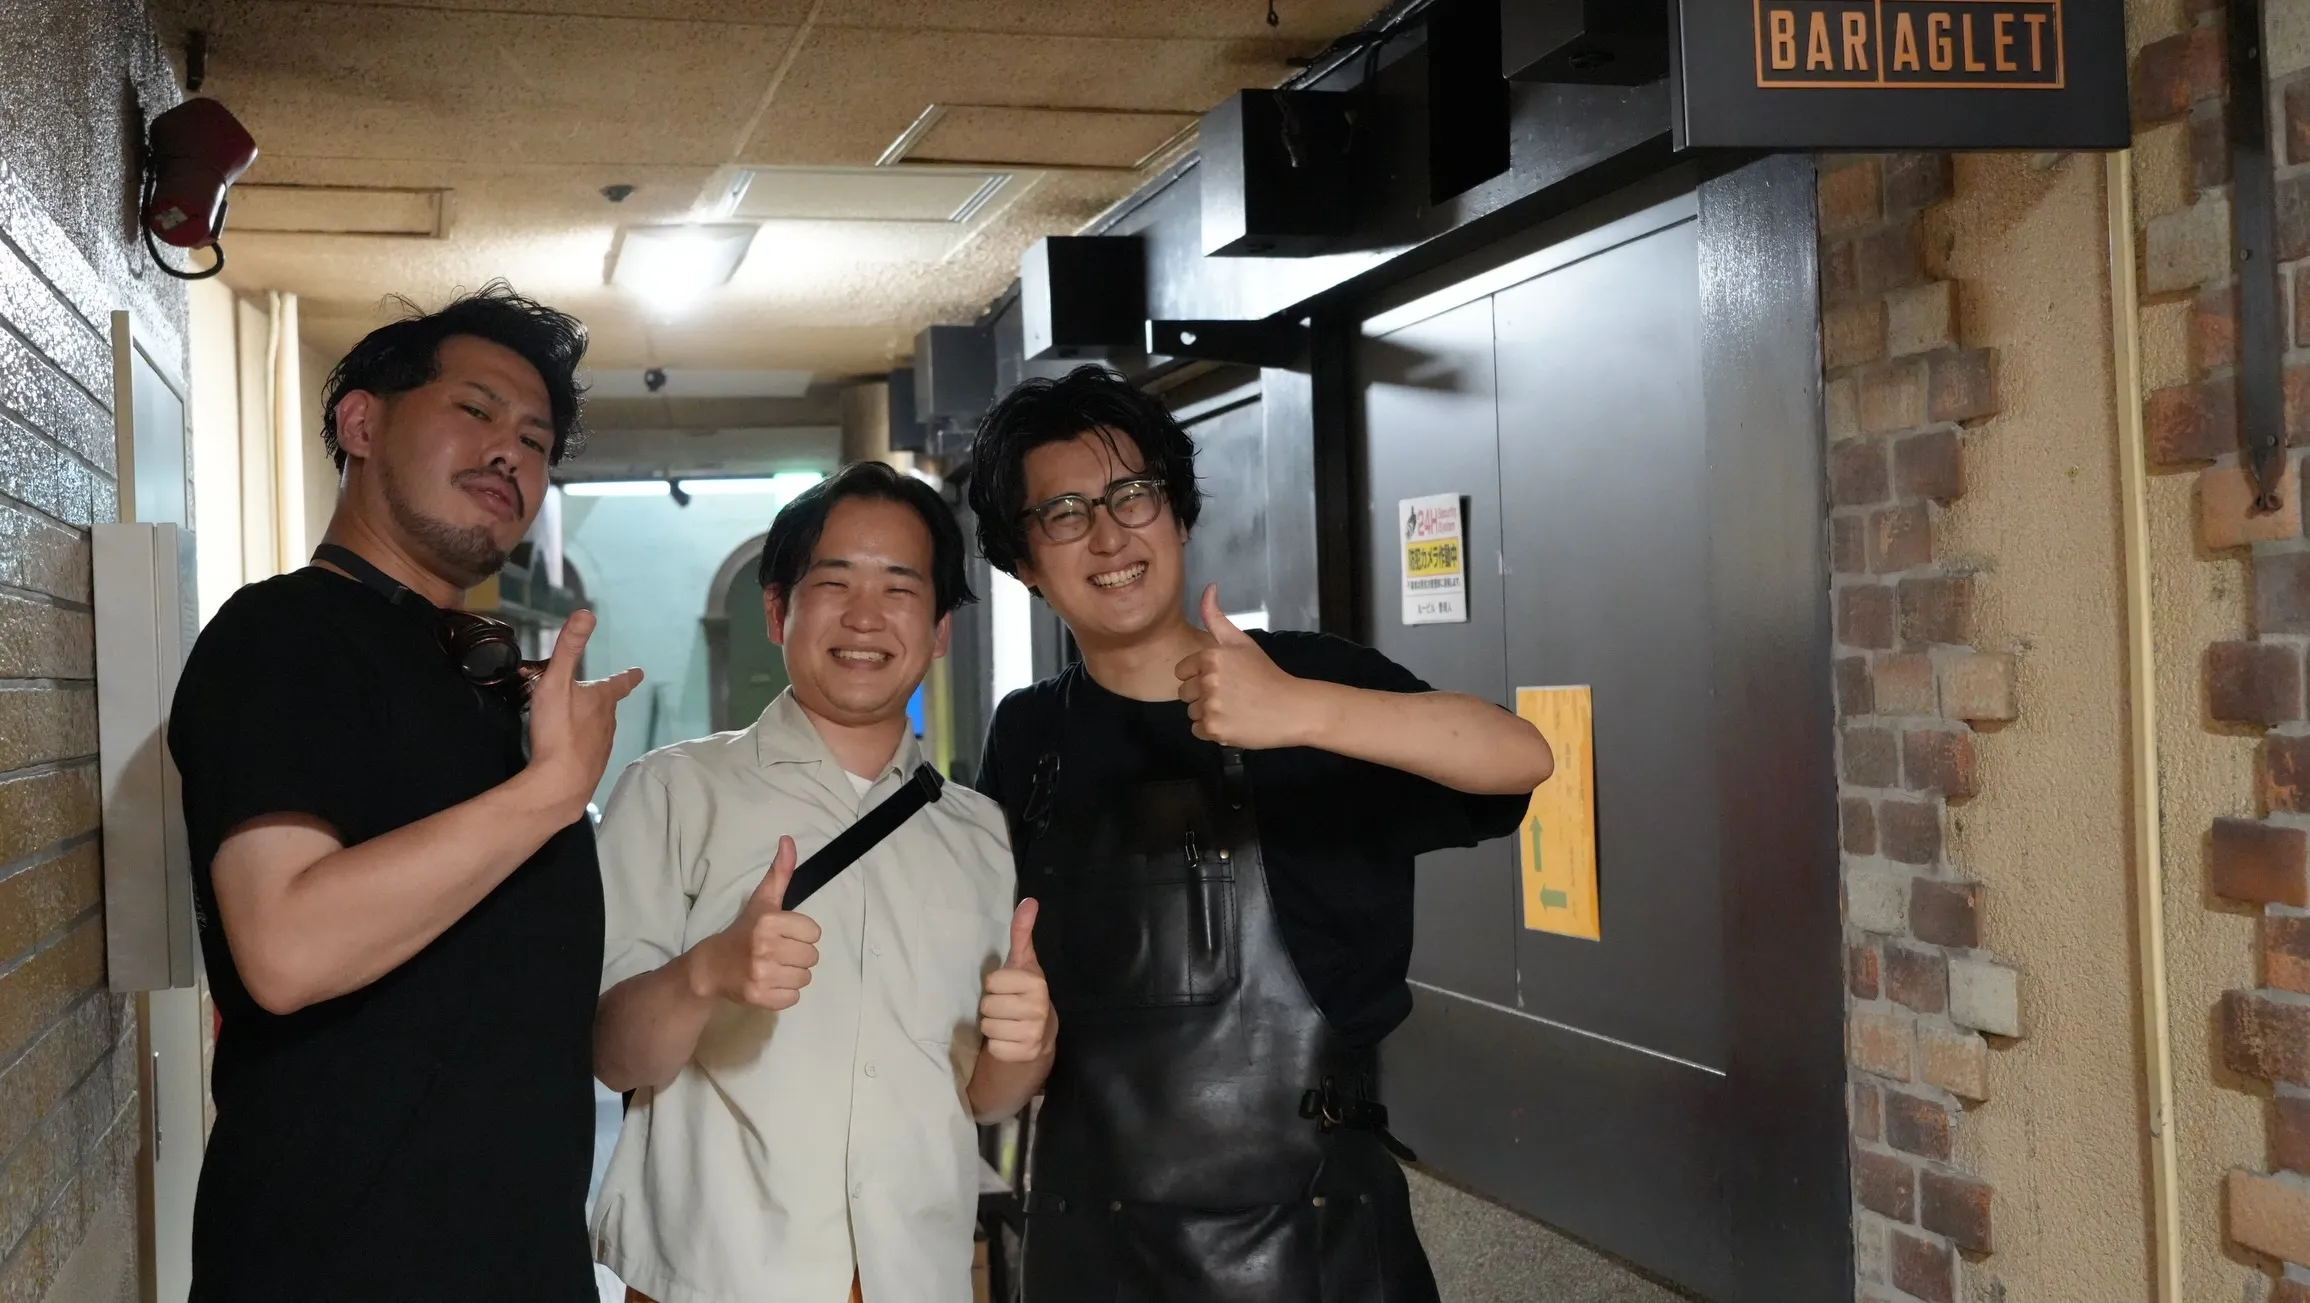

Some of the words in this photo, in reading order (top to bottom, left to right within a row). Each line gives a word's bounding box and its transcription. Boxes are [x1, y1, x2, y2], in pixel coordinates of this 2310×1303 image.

[1770, 10, 1869, 70] BAR
[1894, 11, 2046, 71] AGLET
[1417, 508, 1438, 536] 24H
[1408, 544, 1457, 571] 防犯カメラ作動中
